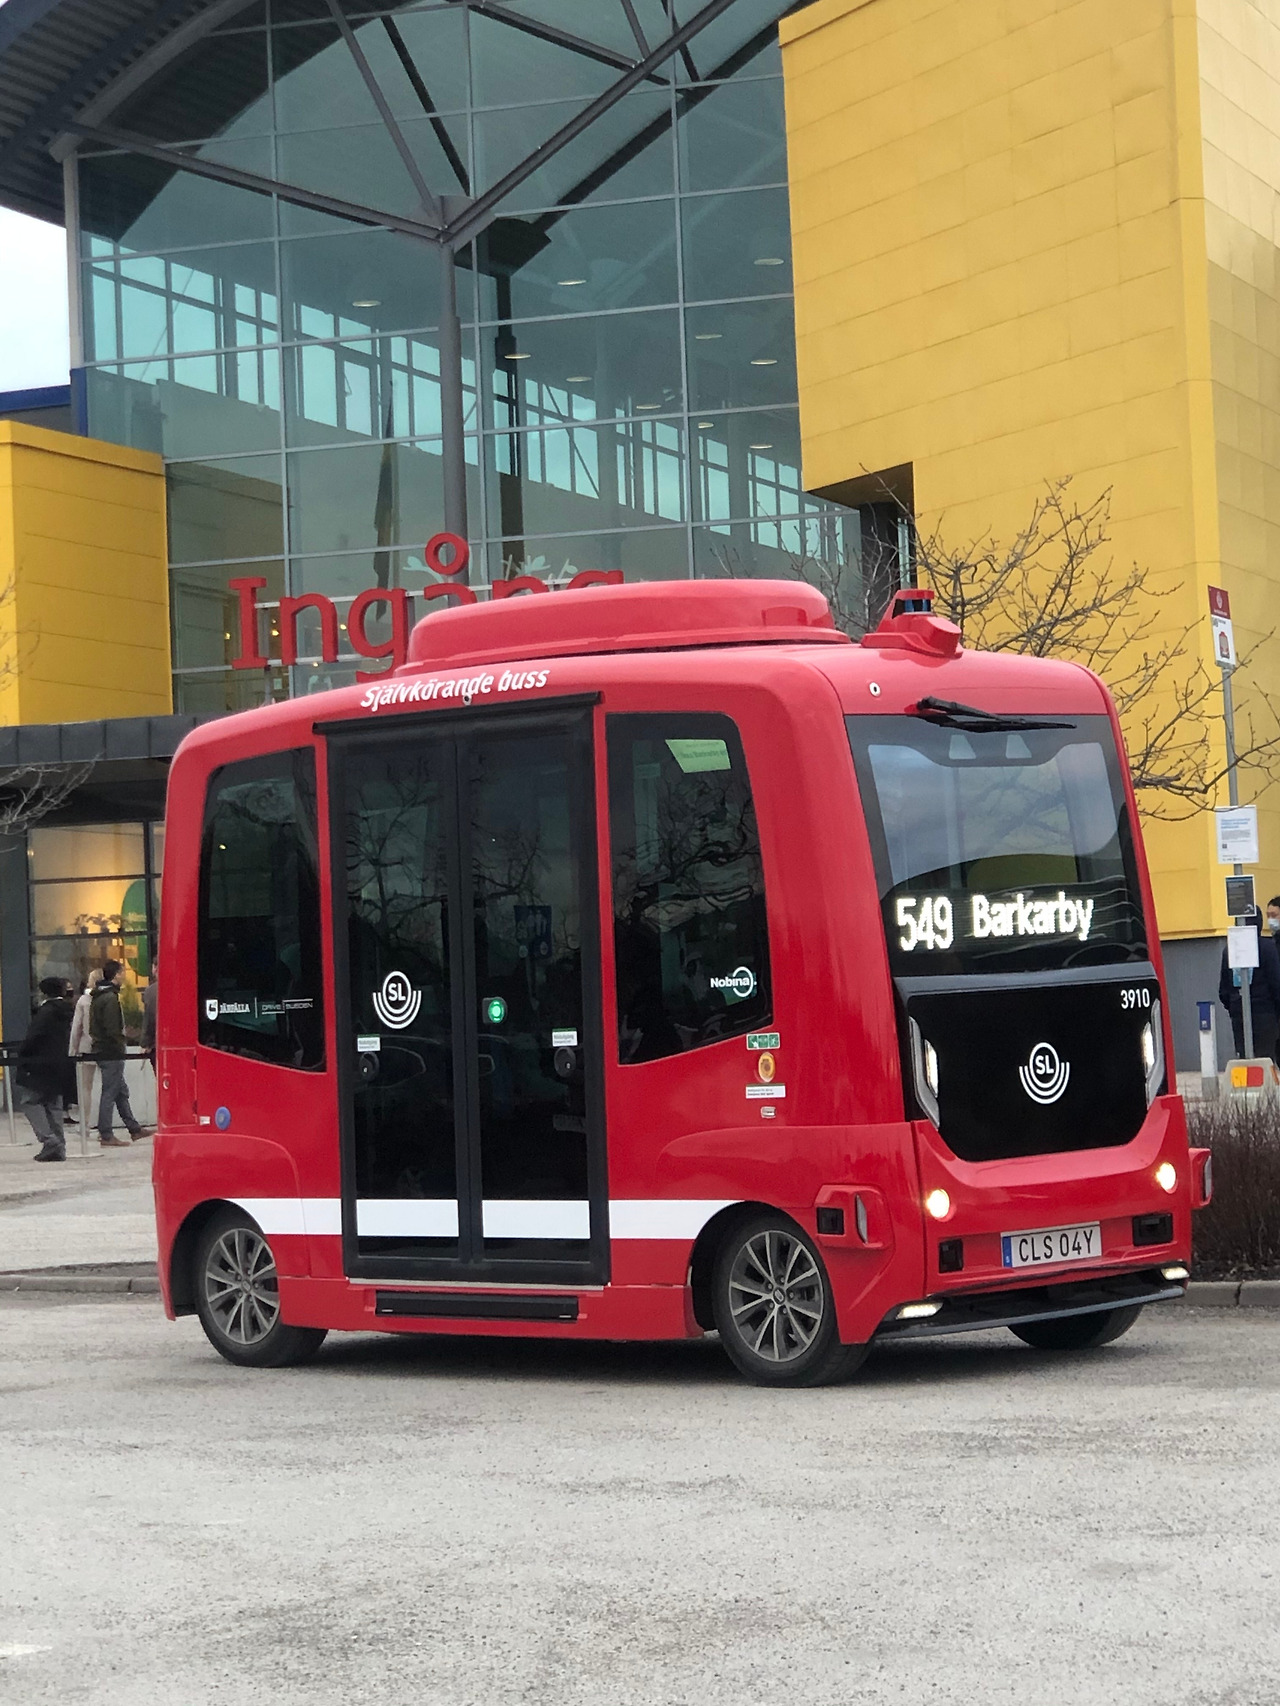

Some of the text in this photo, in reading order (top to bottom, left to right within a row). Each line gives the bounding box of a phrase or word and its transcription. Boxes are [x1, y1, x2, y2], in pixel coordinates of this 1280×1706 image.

[229, 533, 624, 682] Ingå
[360, 670, 550, 712] Självkörande buss
[896, 891, 1095, 951] 549 Barkarby
[1120, 988, 1150, 1009] 3910
[1018, 1229, 1093, 1262] CLS 04Y
